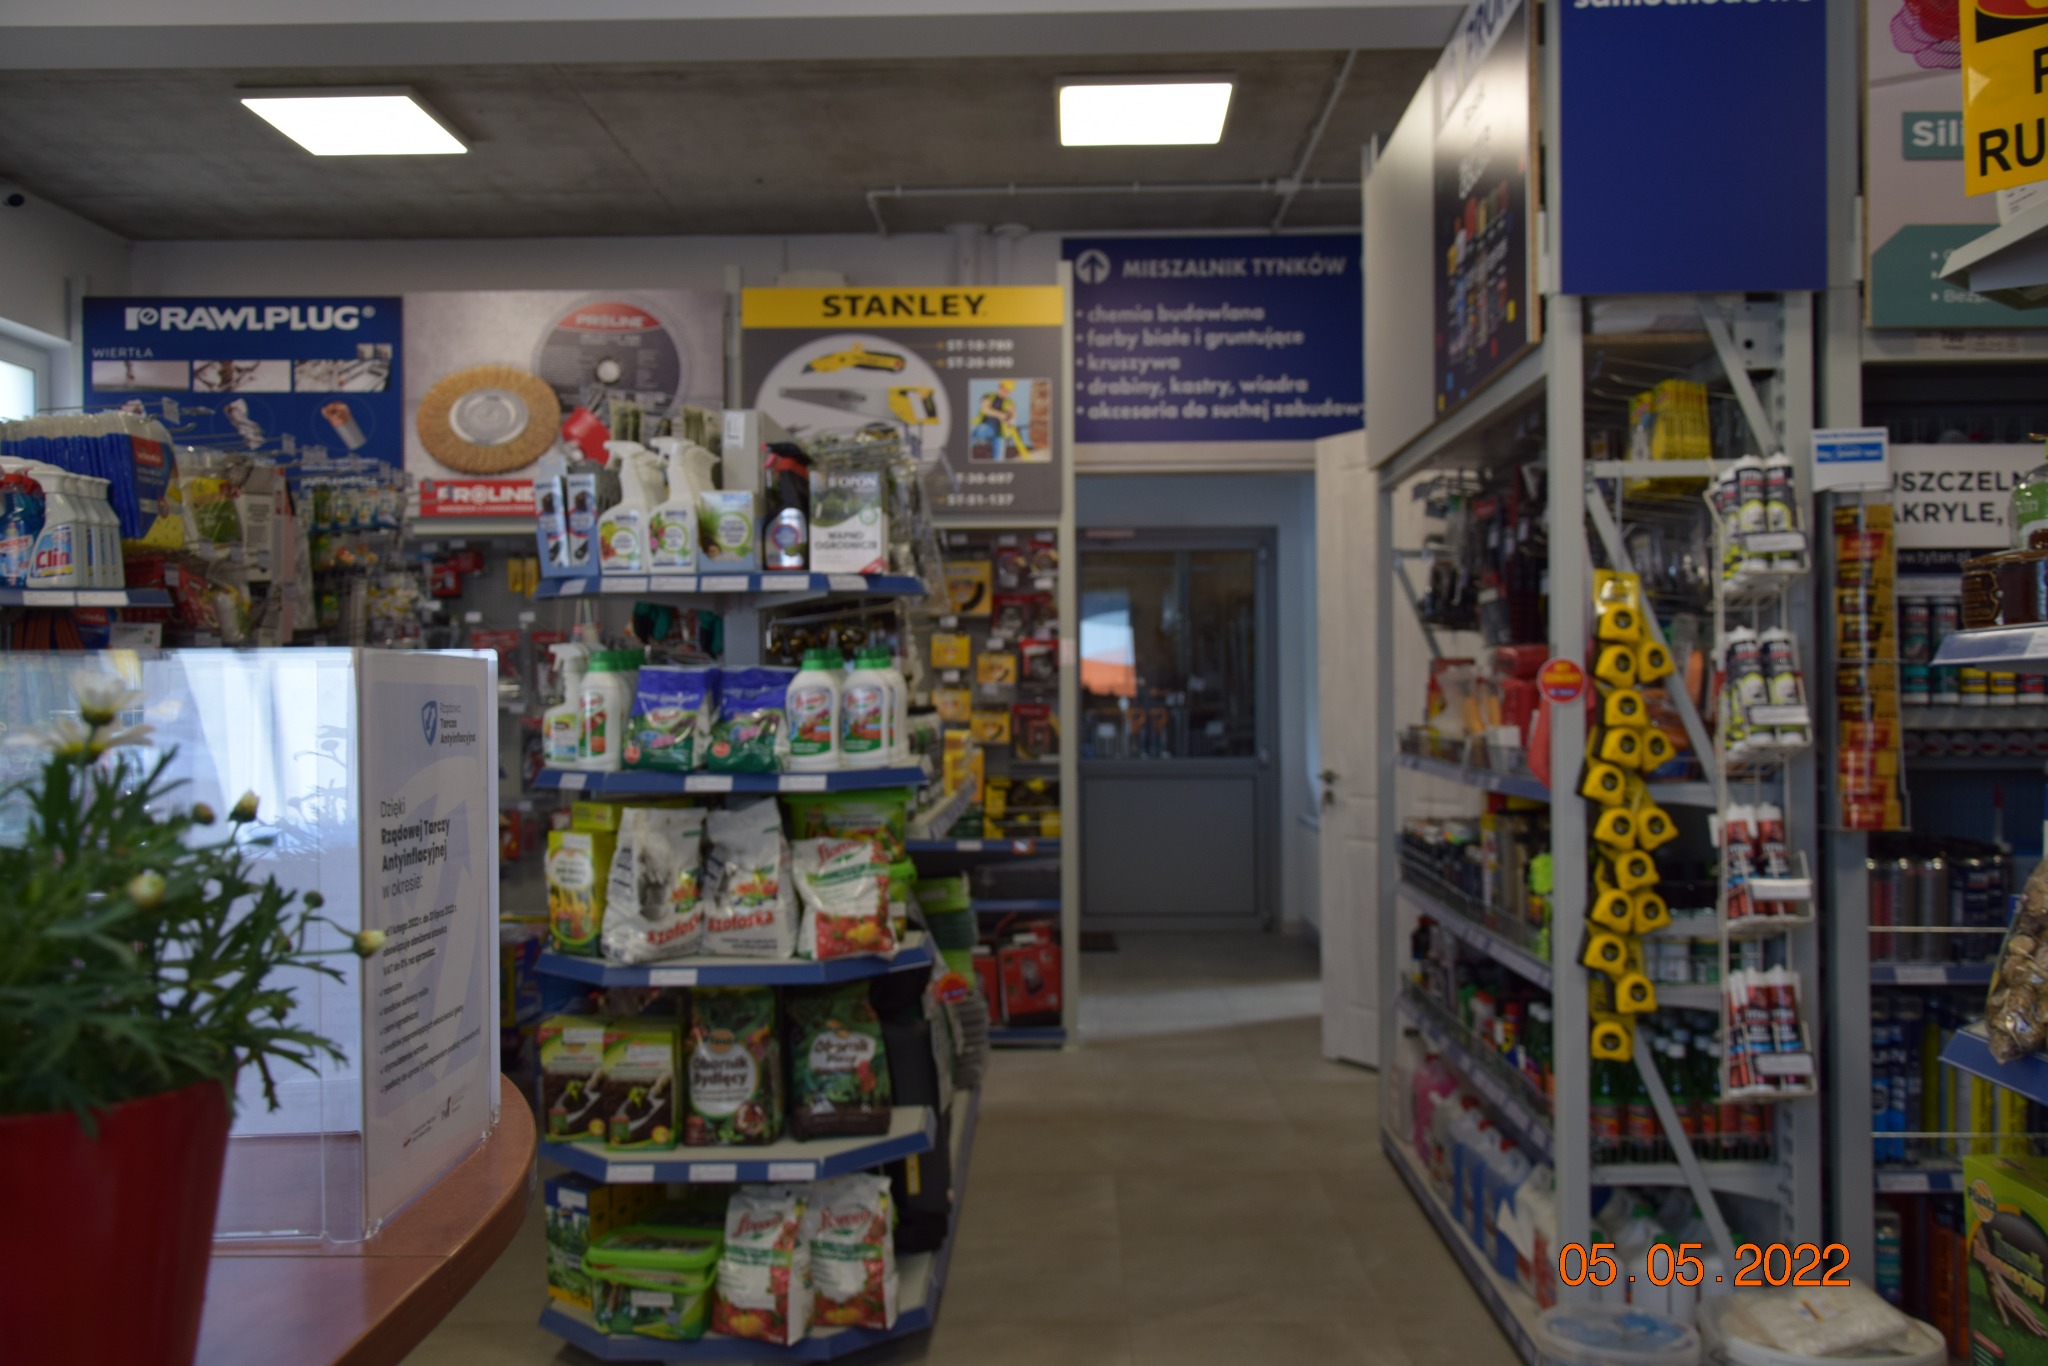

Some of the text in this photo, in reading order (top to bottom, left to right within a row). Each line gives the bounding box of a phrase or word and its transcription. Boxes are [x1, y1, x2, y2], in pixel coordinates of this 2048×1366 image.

[1979, 118, 2046, 177] RU
[1123, 252, 1347, 278] MIESZALNIK TYNKÓW
[822, 294, 985, 318] STANLEY
[1087, 304, 1265, 322] chemia budowlana
[1087, 328, 1304, 351] farby białe i gruntujące
[92, 347, 154, 359] WIERTŁA
[1087, 354, 1181, 373] kruszywa
[1087, 376, 1309, 396] drabiny, kastry, wiadra
[1088, 397, 1364, 422] akcesoria do suchej zabudow
[437, 486, 534, 505] PROLINE
[36, 548, 70, 568] Clin
[440, 718, 457, 728] Tarcza
[440, 731, 475, 747] Antyinflacyjna
[380, 797, 406, 819] Dzięki
[381, 817, 450, 847] Rządowej Tarczy
[382, 840, 447, 874] Antyinflacyjnej
[382, 874, 423, 899] w okresie:
